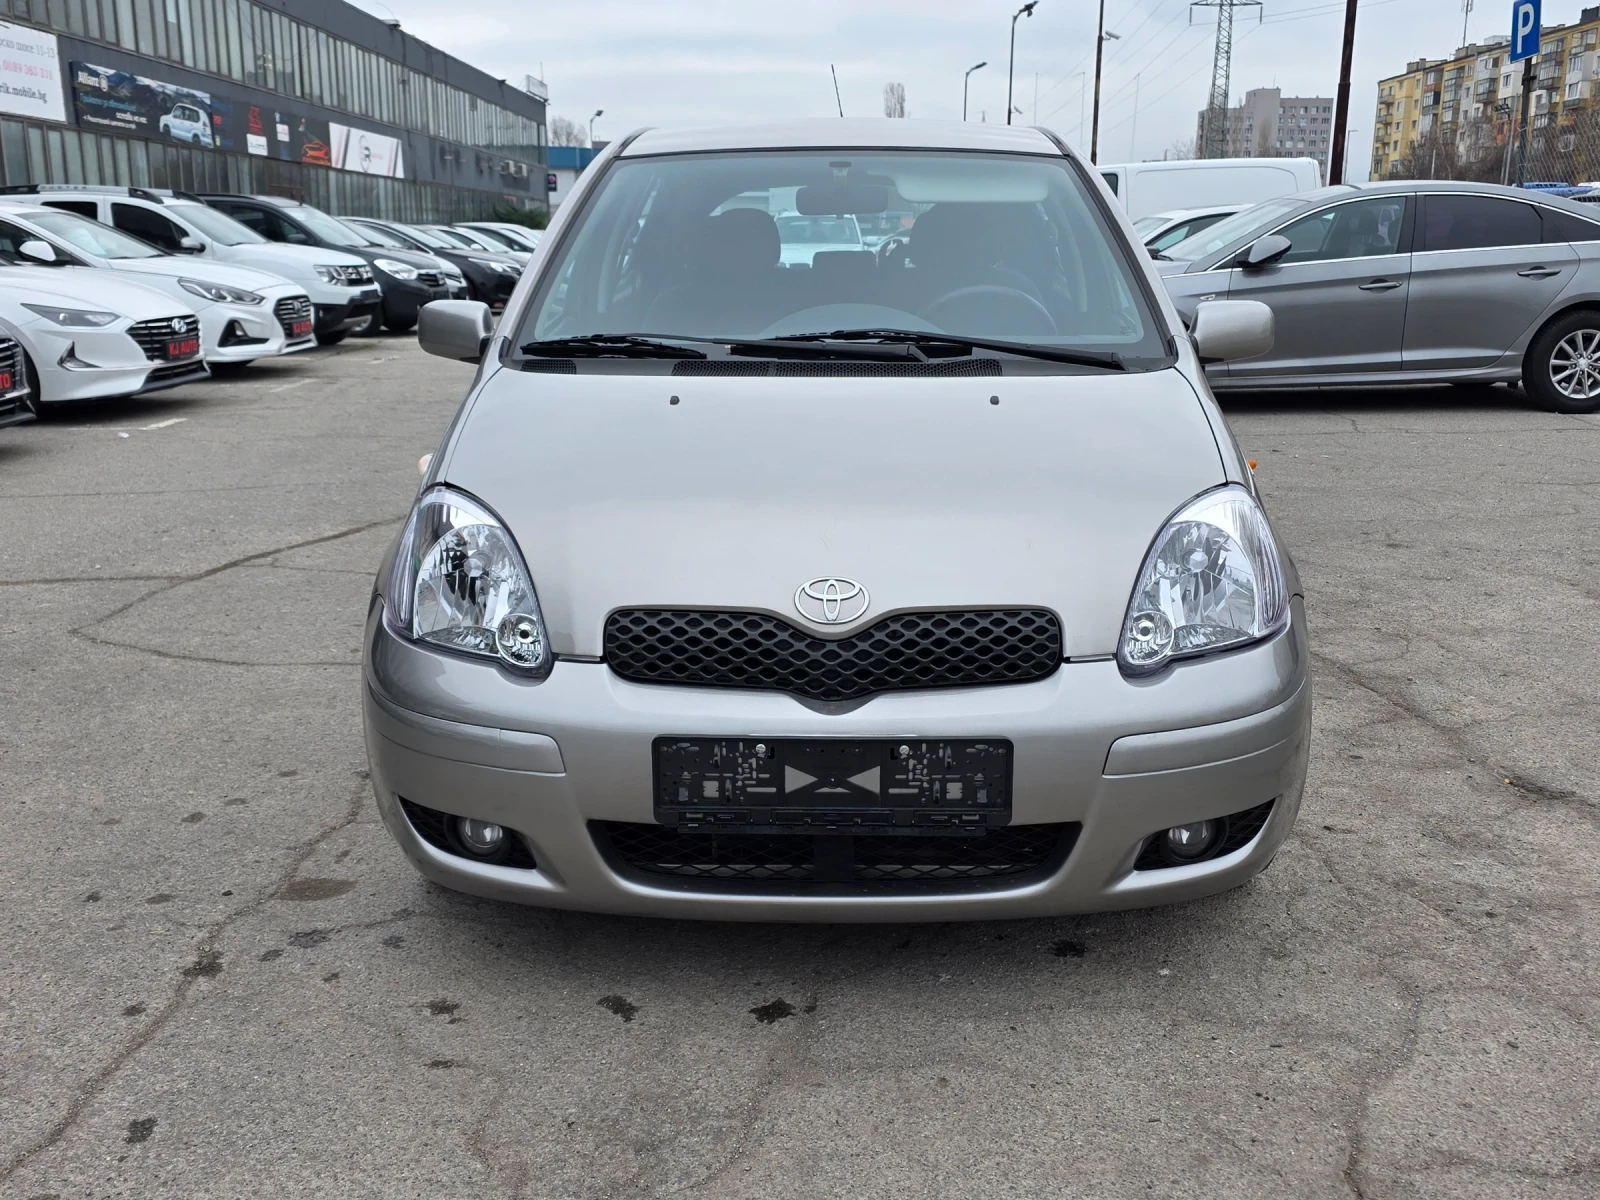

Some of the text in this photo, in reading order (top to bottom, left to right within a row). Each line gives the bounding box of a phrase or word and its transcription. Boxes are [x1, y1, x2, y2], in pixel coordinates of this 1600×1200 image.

[1516, 3, 1535, 54] P
[78, 71, 100, 87] Allianz
[181, 339, 198, 353] AUTO
